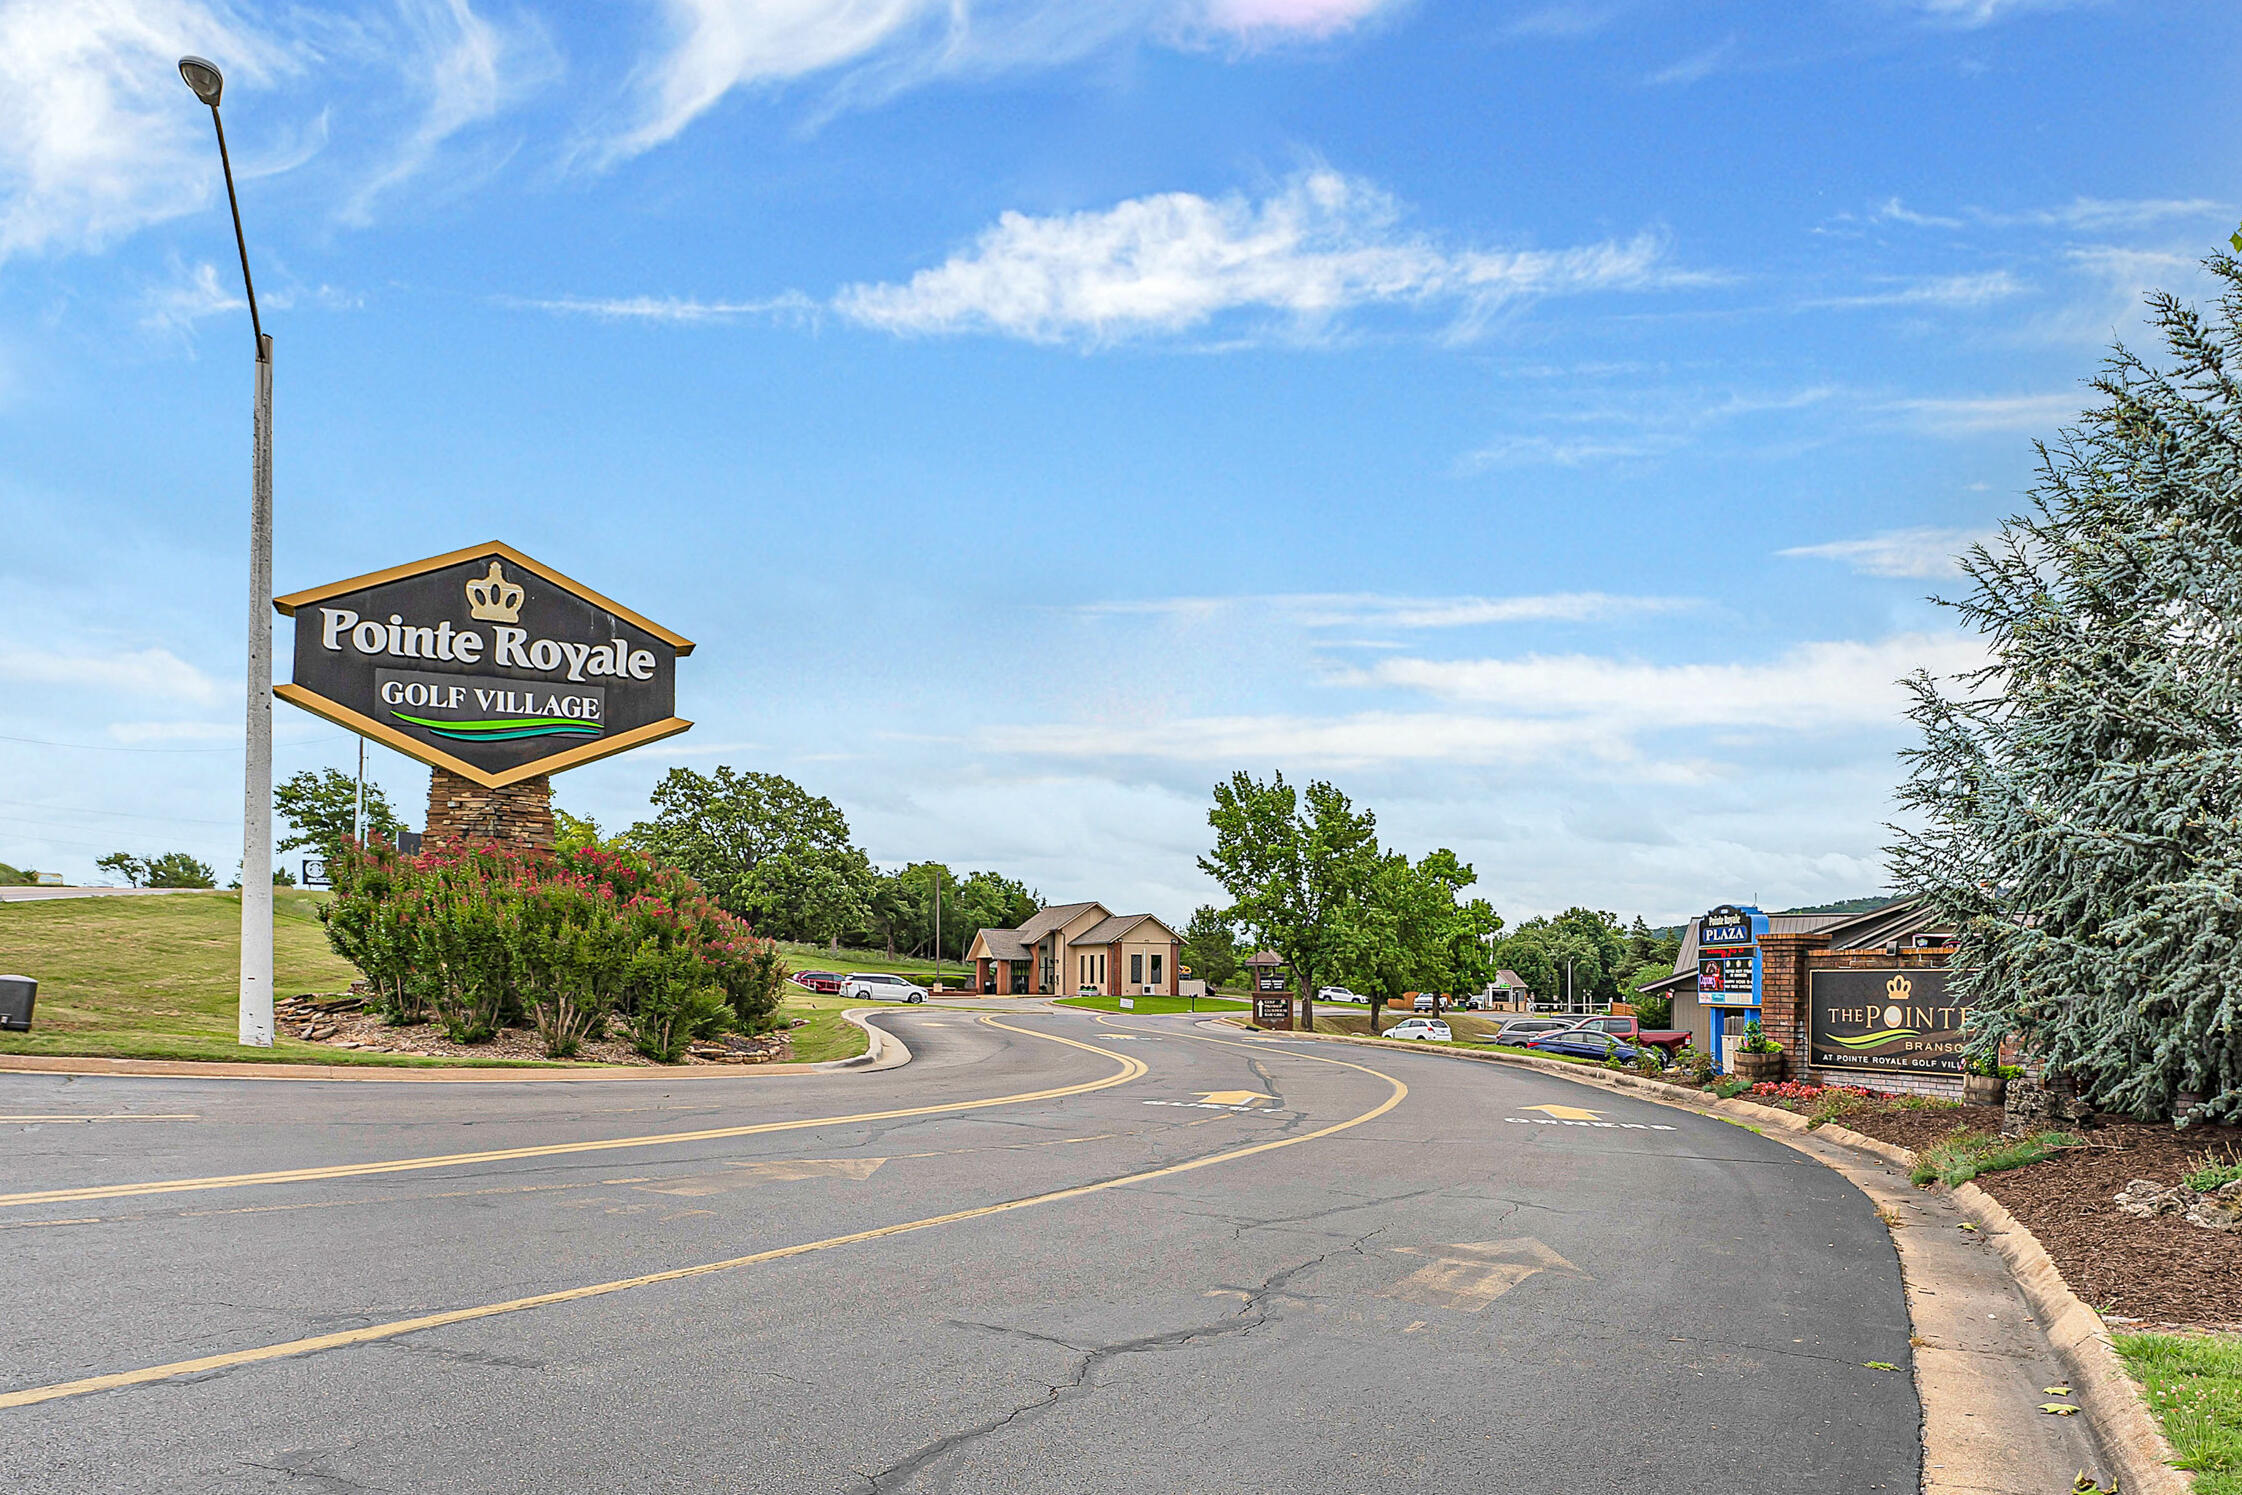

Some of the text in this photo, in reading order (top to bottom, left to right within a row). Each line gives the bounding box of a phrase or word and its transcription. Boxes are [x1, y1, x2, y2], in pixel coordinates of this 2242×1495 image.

[319, 607, 657, 682] Pointe Royale
[380, 680, 601, 720] GOLF VILLAGE
[1705, 927, 1745, 941] PLAZA
[1827, 1008, 1864, 1023] THE
[1905, 1041, 1964, 1053] BRANSO
[1836, 1054, 1869, 1063] POINTE
[1873, 1056, 1908, 1065] ROYALE
[1911, 1059, 1938, 1067] GOLF
